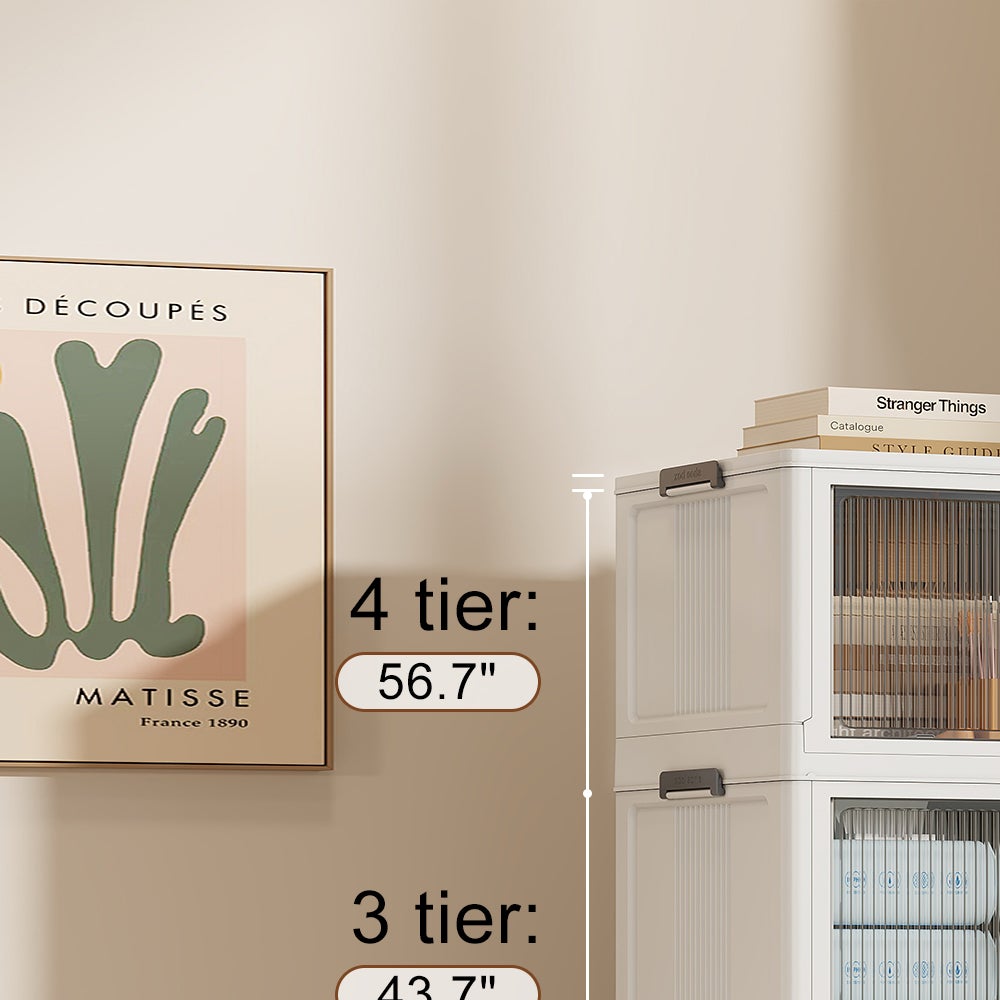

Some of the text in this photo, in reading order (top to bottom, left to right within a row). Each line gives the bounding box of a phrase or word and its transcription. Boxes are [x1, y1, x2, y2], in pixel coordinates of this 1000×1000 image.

[26, 295, 228, 321] DÉCOUPÉS
[876, 396, 987, 416] Stranger Things
[830, 421, 884, 433] Catalogue
[872, 443, 933, 455] STYLE
[76, 687, 250, 708] MATISSE
[141, 717, 249, 728] France 1890
